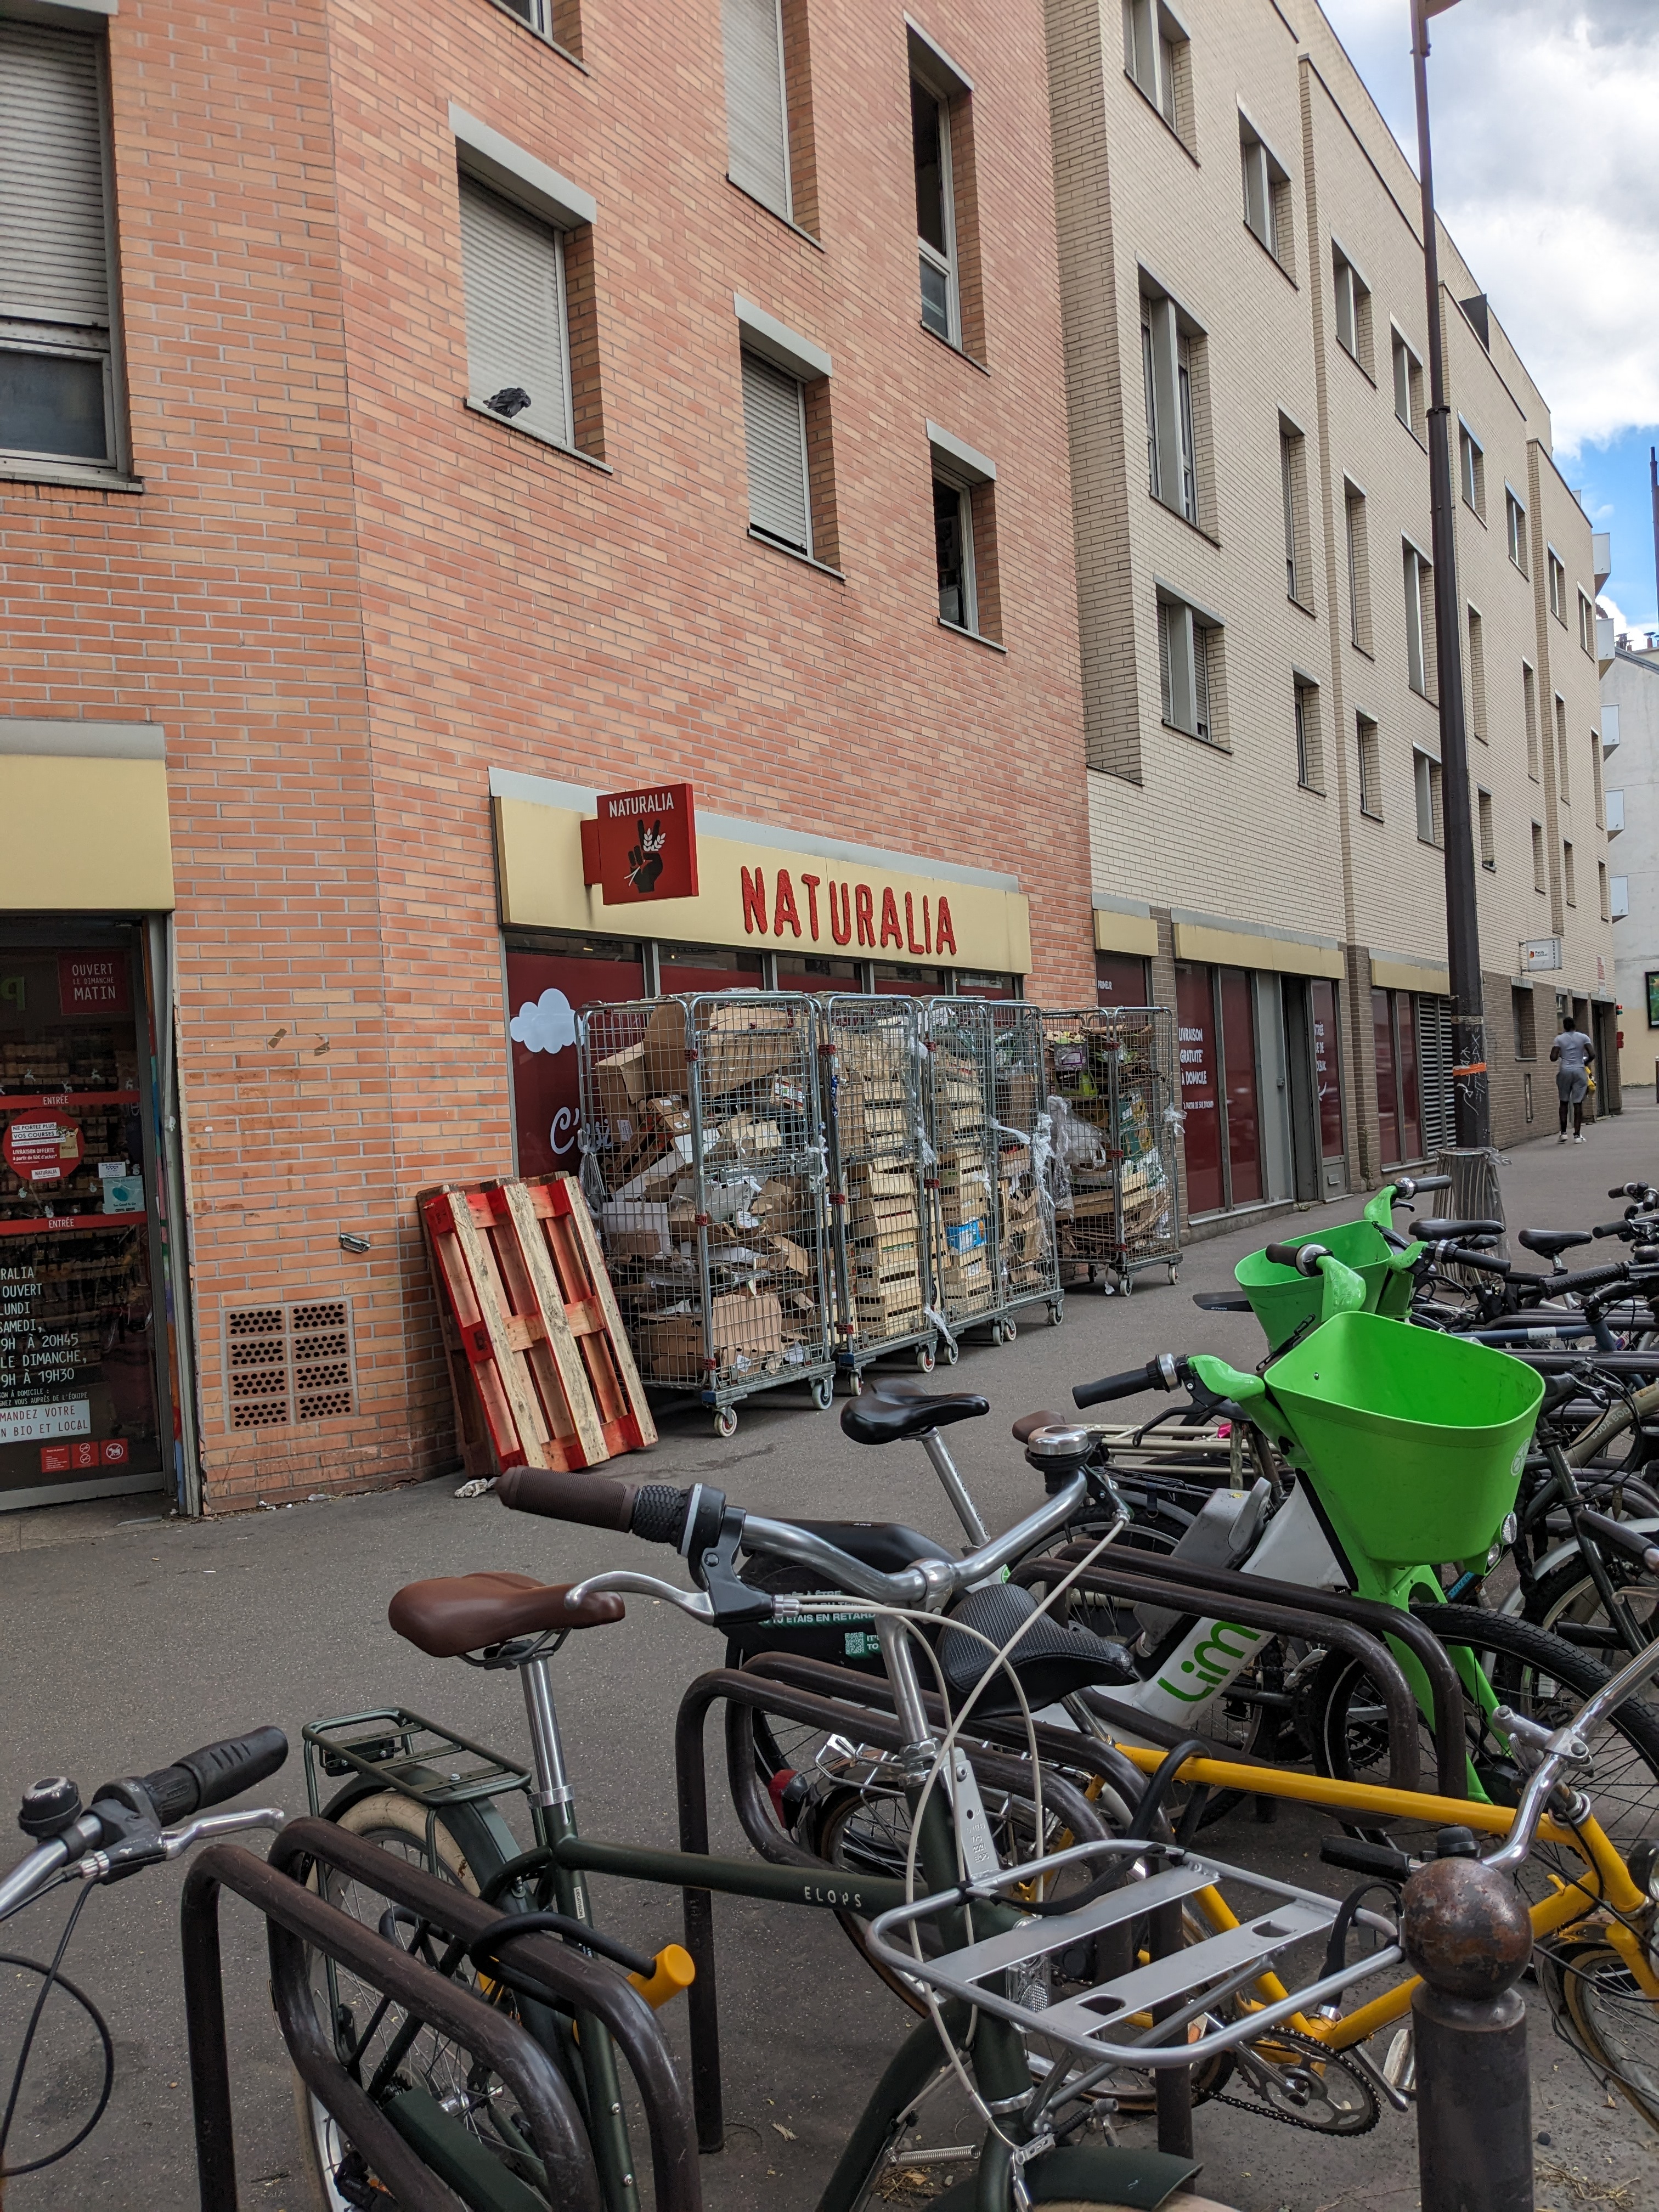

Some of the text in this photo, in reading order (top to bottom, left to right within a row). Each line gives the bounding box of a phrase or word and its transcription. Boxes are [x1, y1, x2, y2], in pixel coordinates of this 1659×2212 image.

[608, 792, 674, 817] NATURALIA
[741, 865, 957, 956] NATURALIA
[72, 963, 112, 975] OUVERT
[74, 986, 116, 1000] MATIN
[1178, 1028, 1203, 1042] LIVRAISON
[1181, 1068, 1207, 1086] À DOMICILE
[43, 1093, 69, 1105] ENTRÉE
[48, 1217, 75, 1228] ENTRÉE
[1, 1266, 35, 1280] RALIA
[2, 1283, 42, 1298] OUVERT
[1, 1333, 79, 1352] 9H À 20H45
[1, 1350, 87, 1369] LE DIMANCHE,
[1, 1368, 75, 1388] 9H À 19H30
[10, 1389, 15, 1397] À
[17, 1388, 43, 1396] DOMICILE
[31, 1395, 50, 1404] AUPRÈS
[62, 1392, 88, 1401] L'ÉQUIPE
[45, 1405, 76, 1418] VOTRE
[14, 1425, 32, 1437] BIO
[40, 1423, 51, 1434] ET
[58, 1419, 88, 1432] LOCAL
[816, 1613, 830, 1622] EN
[575, 1888, 584, 1917] DECATHLON
[804, 1886, 862, 1908] ELOPS
